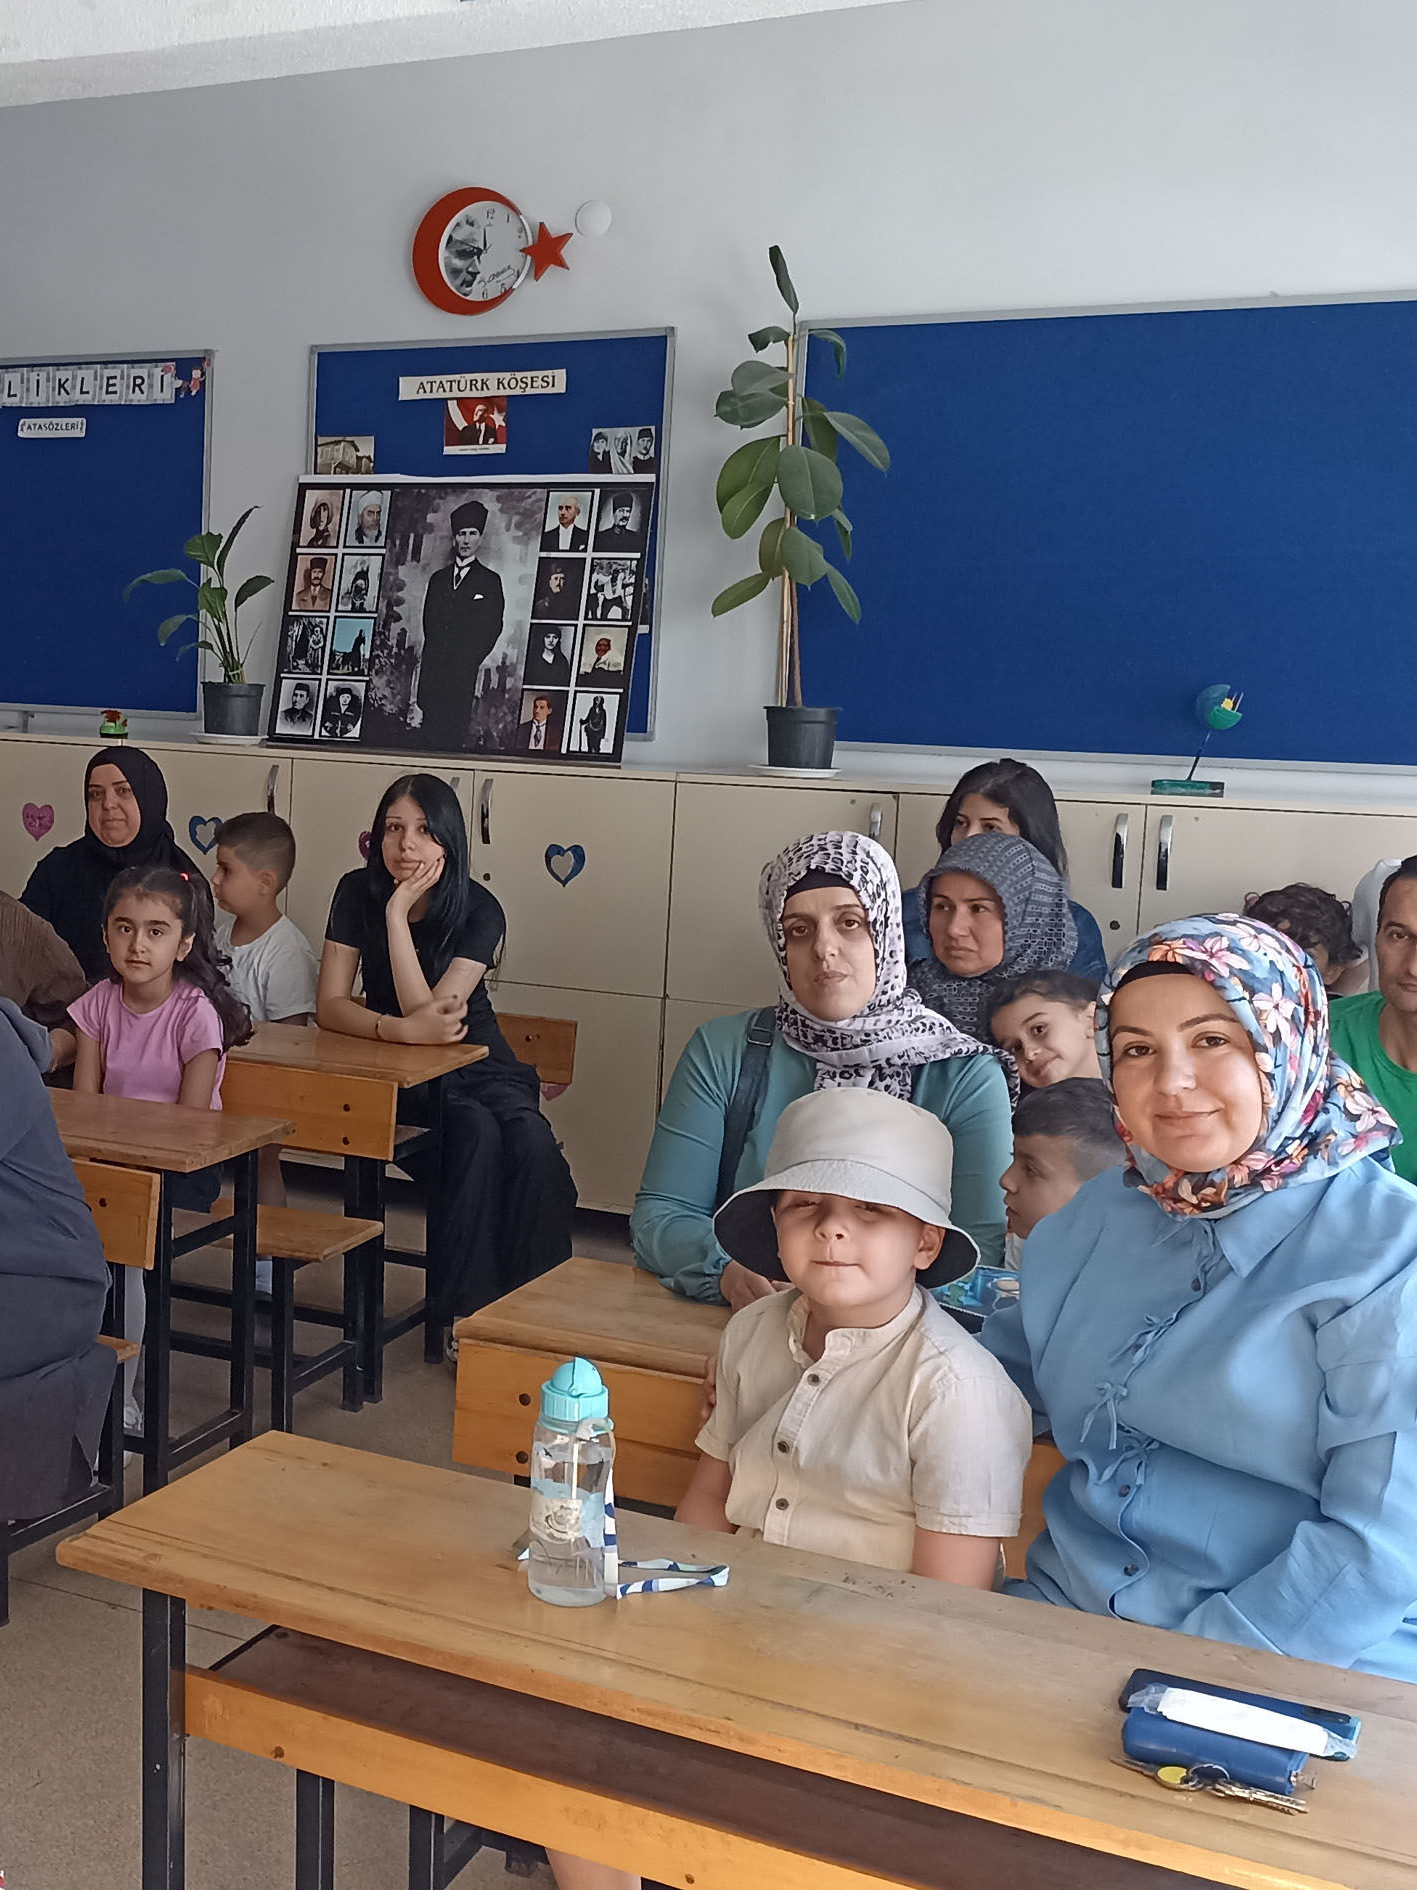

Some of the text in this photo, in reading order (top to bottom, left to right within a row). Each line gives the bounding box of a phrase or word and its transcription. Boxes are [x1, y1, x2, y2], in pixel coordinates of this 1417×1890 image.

[416, 371, 556, 395] ATATÜRK KÖŞESİ
[26, 420, 79, 432] ATASÖZLERİ
